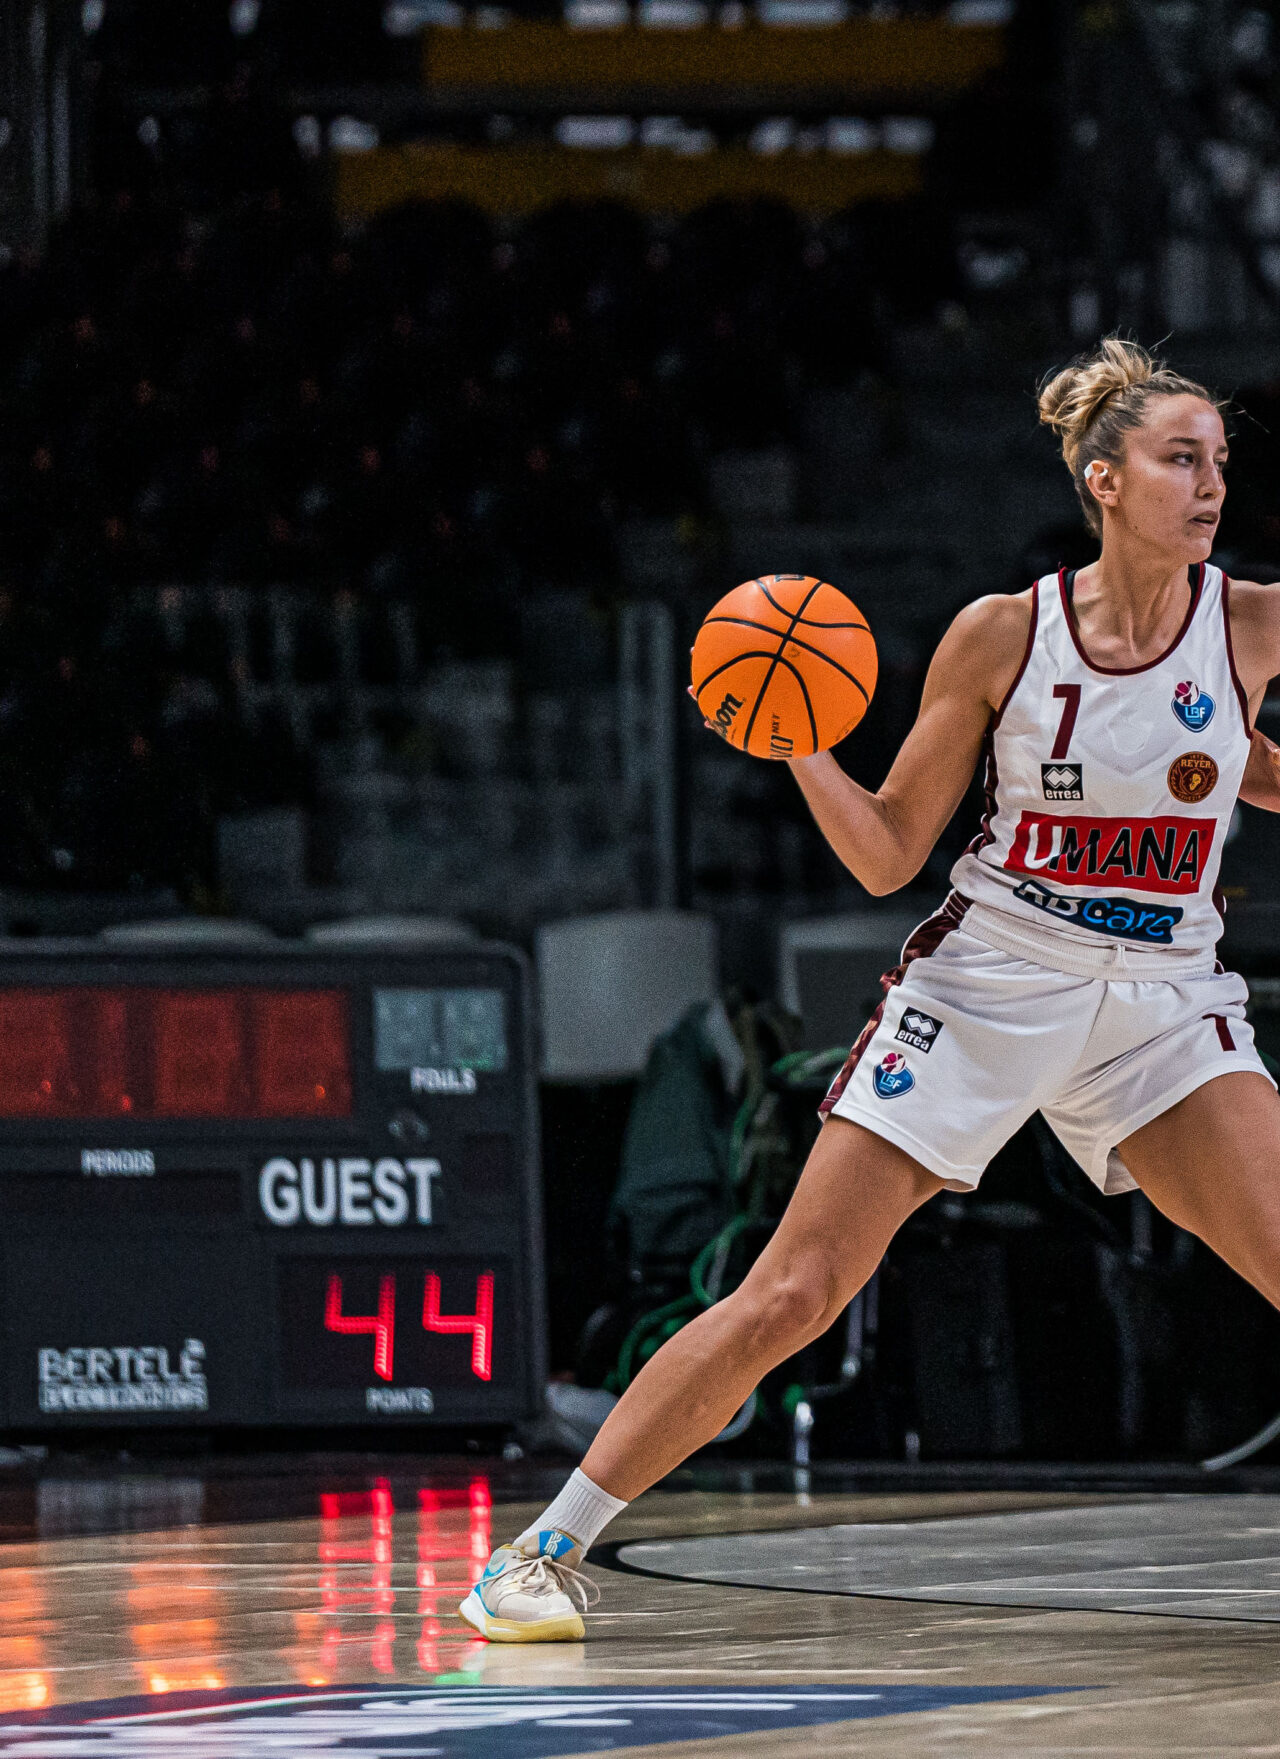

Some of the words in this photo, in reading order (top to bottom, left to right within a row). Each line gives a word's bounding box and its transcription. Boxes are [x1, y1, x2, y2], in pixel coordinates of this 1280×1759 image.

[771, 712, 782, 734] NXT
[1050, 684, 1081, 760] 7
[1184, 706, 1206, 719] LBF
[1181, 758, 1211, 769] REYER
[1045, 787, 1081, 800] errea
[1023, 822, 1200, 882] UMANA
[897, 1029, 930, 1051] errea
[880, 1072, 902, 1090] LBF
[258, 1157, 442, 1227] GUEST
[324, 1267, 496, 1382] 44
[366, 1386, 434, 1414] POINTS
